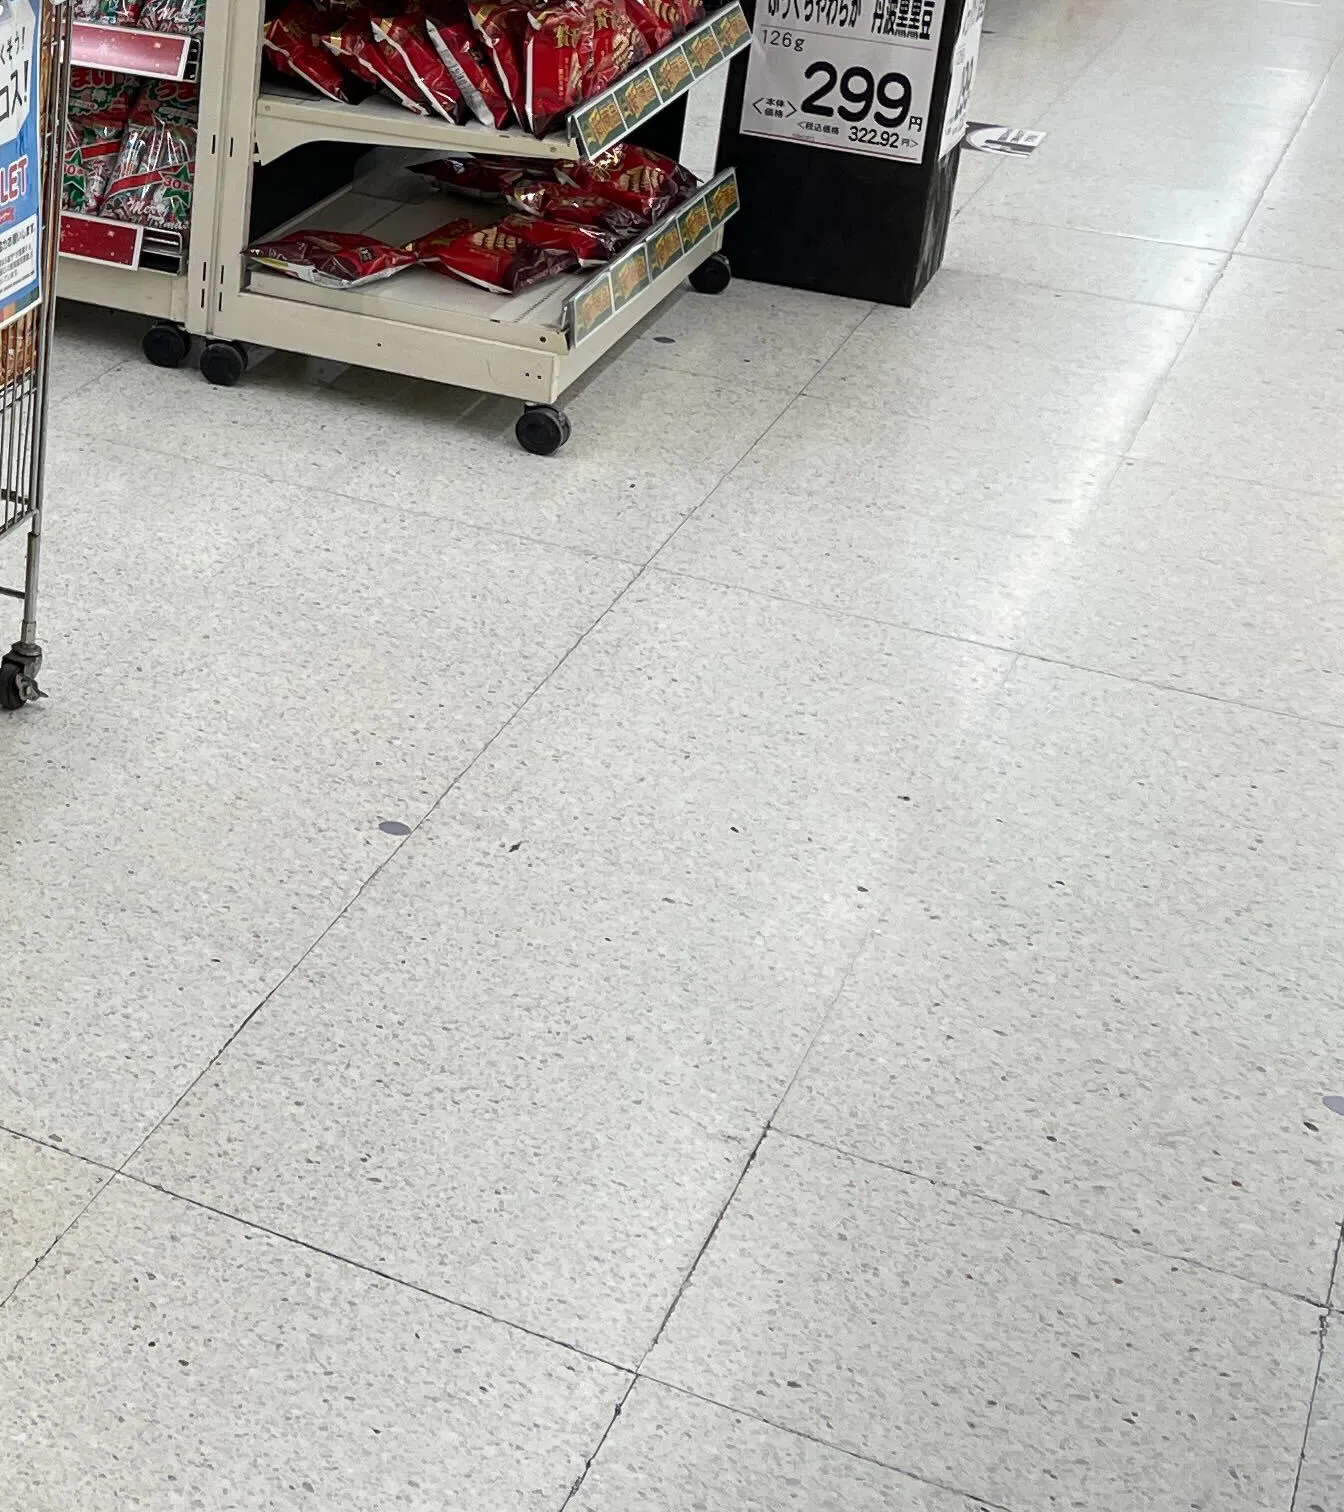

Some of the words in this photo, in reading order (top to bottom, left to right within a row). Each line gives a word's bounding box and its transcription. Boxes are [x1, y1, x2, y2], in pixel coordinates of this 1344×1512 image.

[761, 29, 806, 52] 126g
[765, 97, 785, 108] 本体
[801, 60, 913, 128] 299
[763, 107, 784, 119] 価格
[847, 125, 900, 149] 322.92
